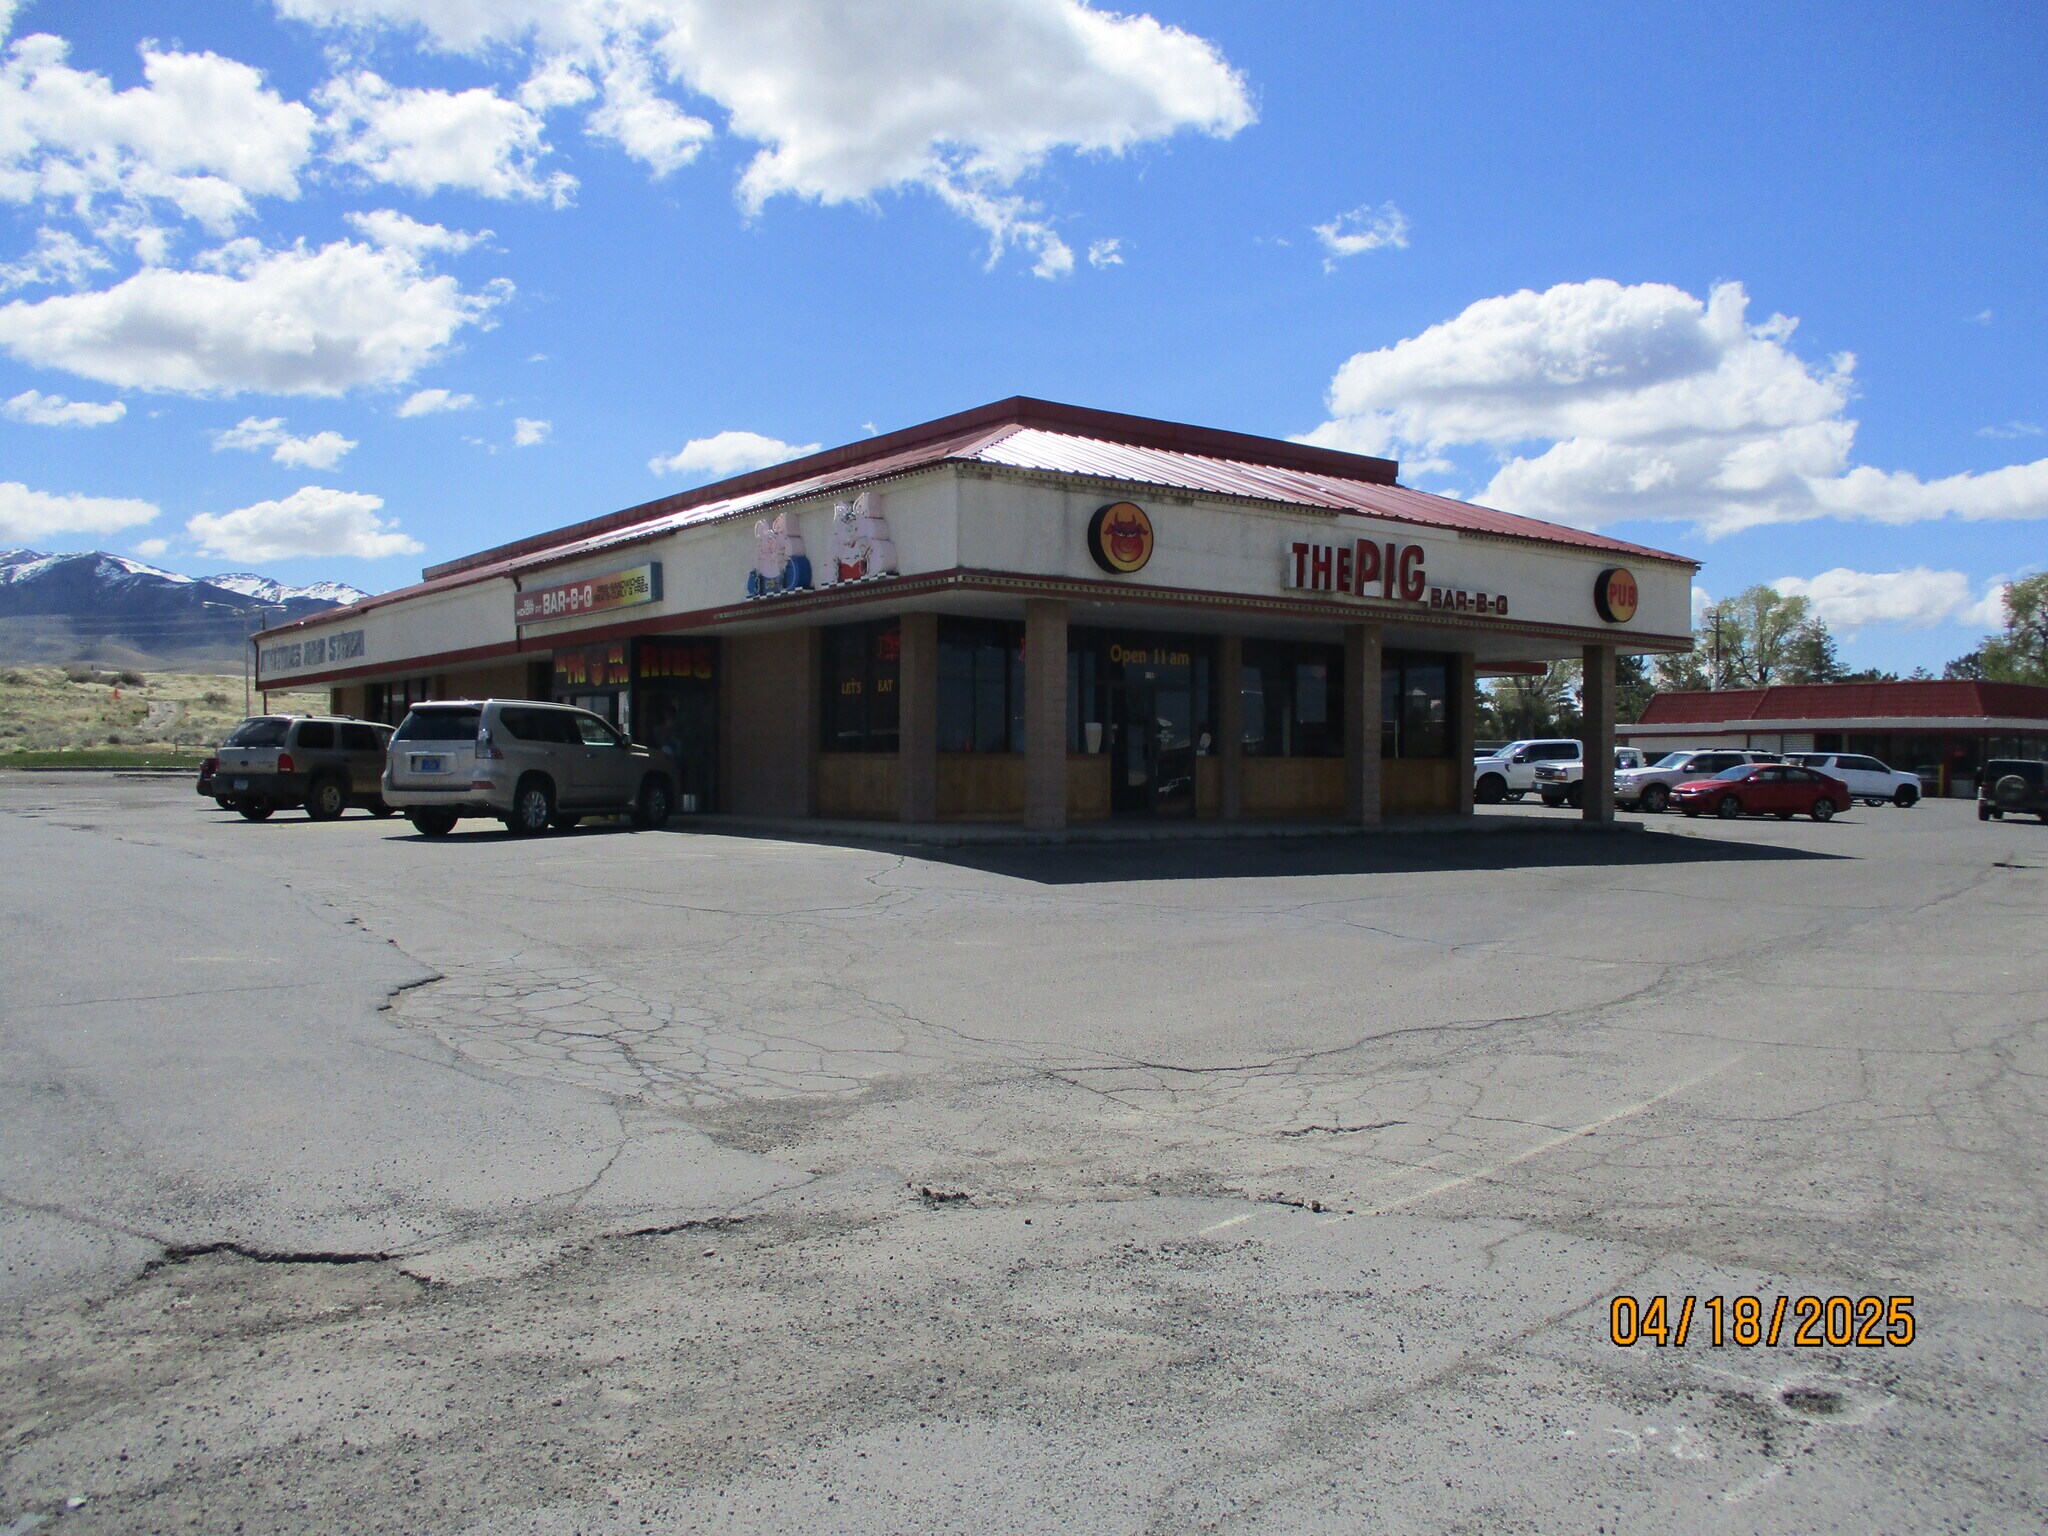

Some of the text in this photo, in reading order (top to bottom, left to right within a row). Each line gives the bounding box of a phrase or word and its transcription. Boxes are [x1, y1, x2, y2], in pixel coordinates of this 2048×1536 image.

[1290, 538, 1426, 602] THE PIG
[542, 584, 593, 616] BAR-B-Q
[634, 582, 649, 595] FRIES
[1430, 587, 1509, 616] BAR-B-Q
[1609, 582, 1636, 607] PUB
[567, 653, 586, 684] PIG
[640, 645, 712, 680] RIBS
[1110, 644, 1190, 667] Open 11 am
[878, 679, 894, 692] EAT
